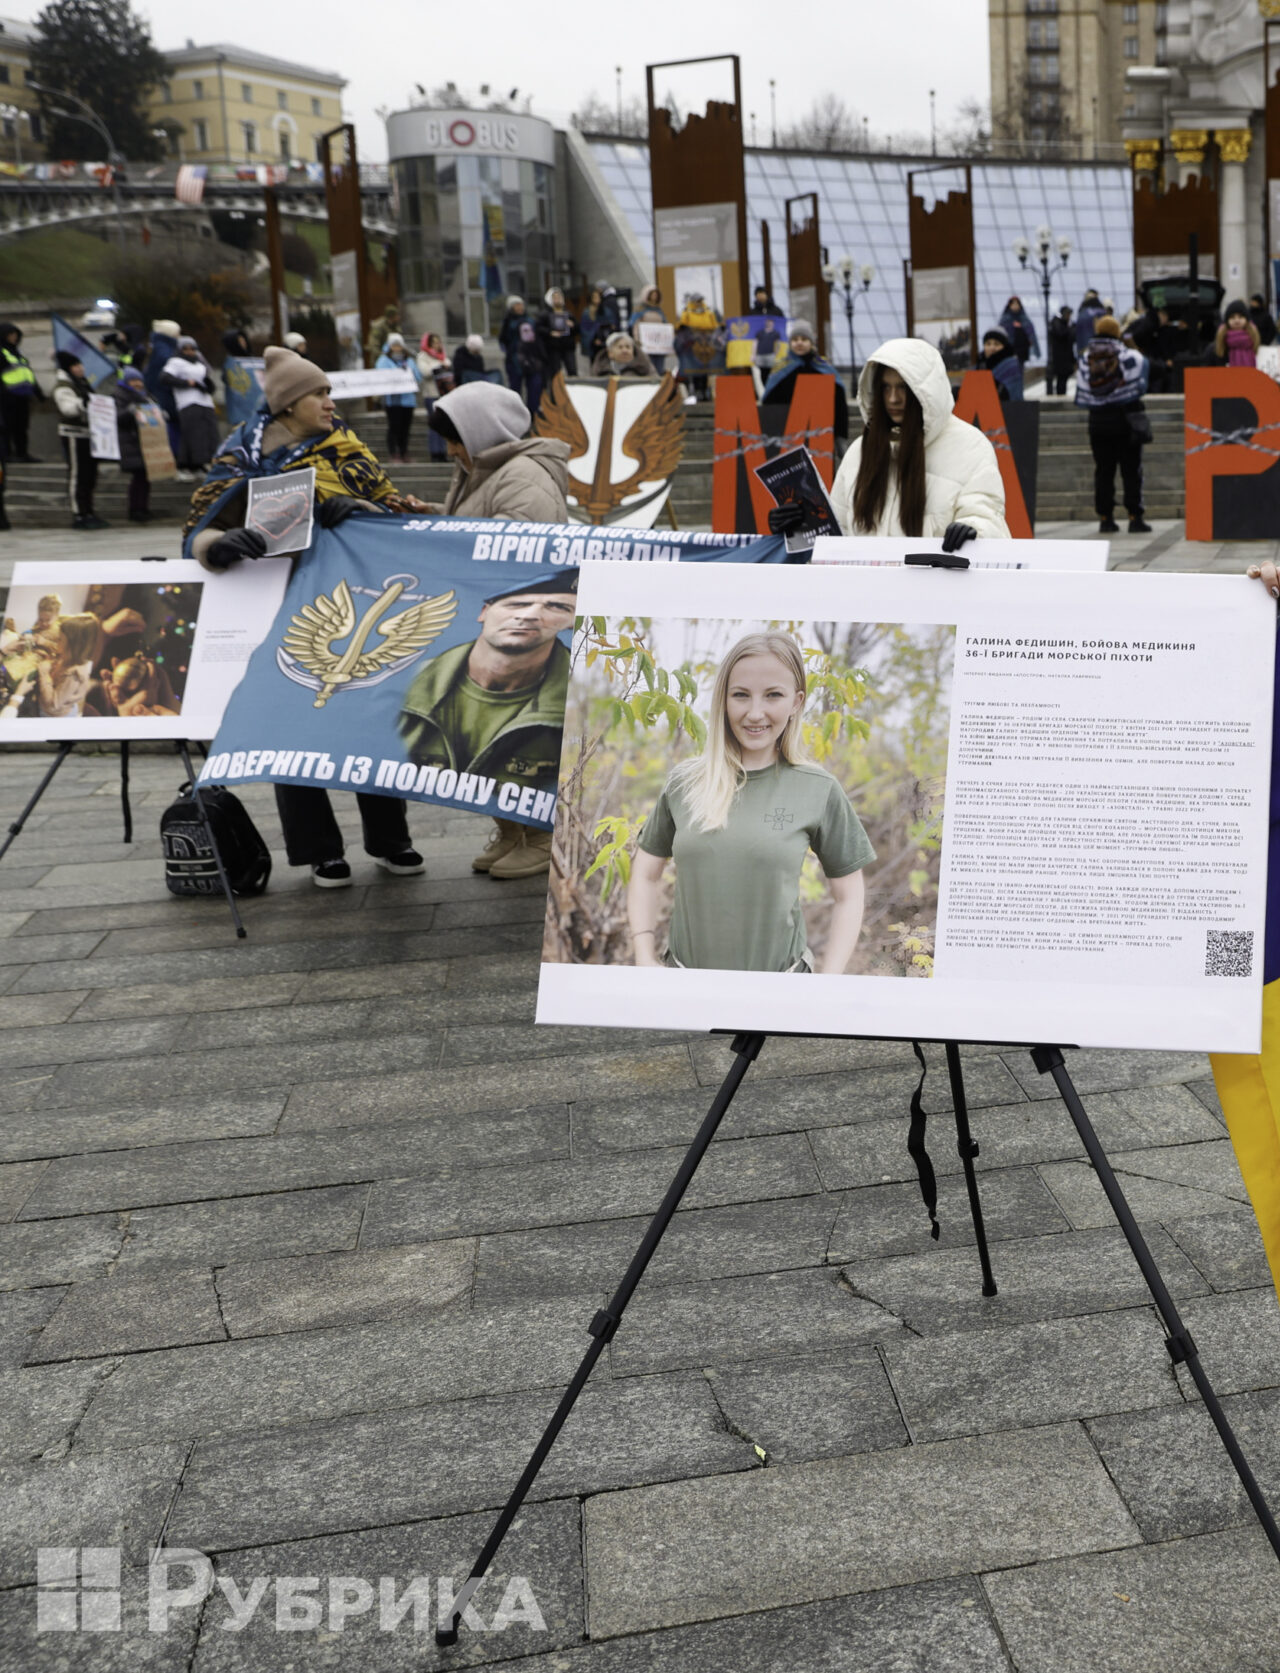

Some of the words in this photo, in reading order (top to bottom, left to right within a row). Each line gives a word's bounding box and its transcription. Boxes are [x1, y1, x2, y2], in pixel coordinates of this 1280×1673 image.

[426, 119, 520, 151] GLOBUS
[473, 534, 548, 564] ВІРНІ
[965, 637, 1011, 646] ГАЛИНА
[1014, 638, 1078, 648] ФЕДИШИН,
[1081, 639, 1128, 649] БОЙОВА
[1131, 641, 1196, 651] МЕДИКИНЯ
[965, 648, 988, 657] 36-Ї
[990, 650, 1044, 659] БРИГАДИ
[1046, 651, 1106, 660] МОРСЬКОЇ
[1109, 653, 1153, 662] ПІХОТИ
[200, 750, 336, 783] ПОВЕРНІТЬ
[340, 755, 373, 782] ІЗ
[375, 760, 495, 806] ПОЛОНУ
[498, 782, 557, 825] СЕН
